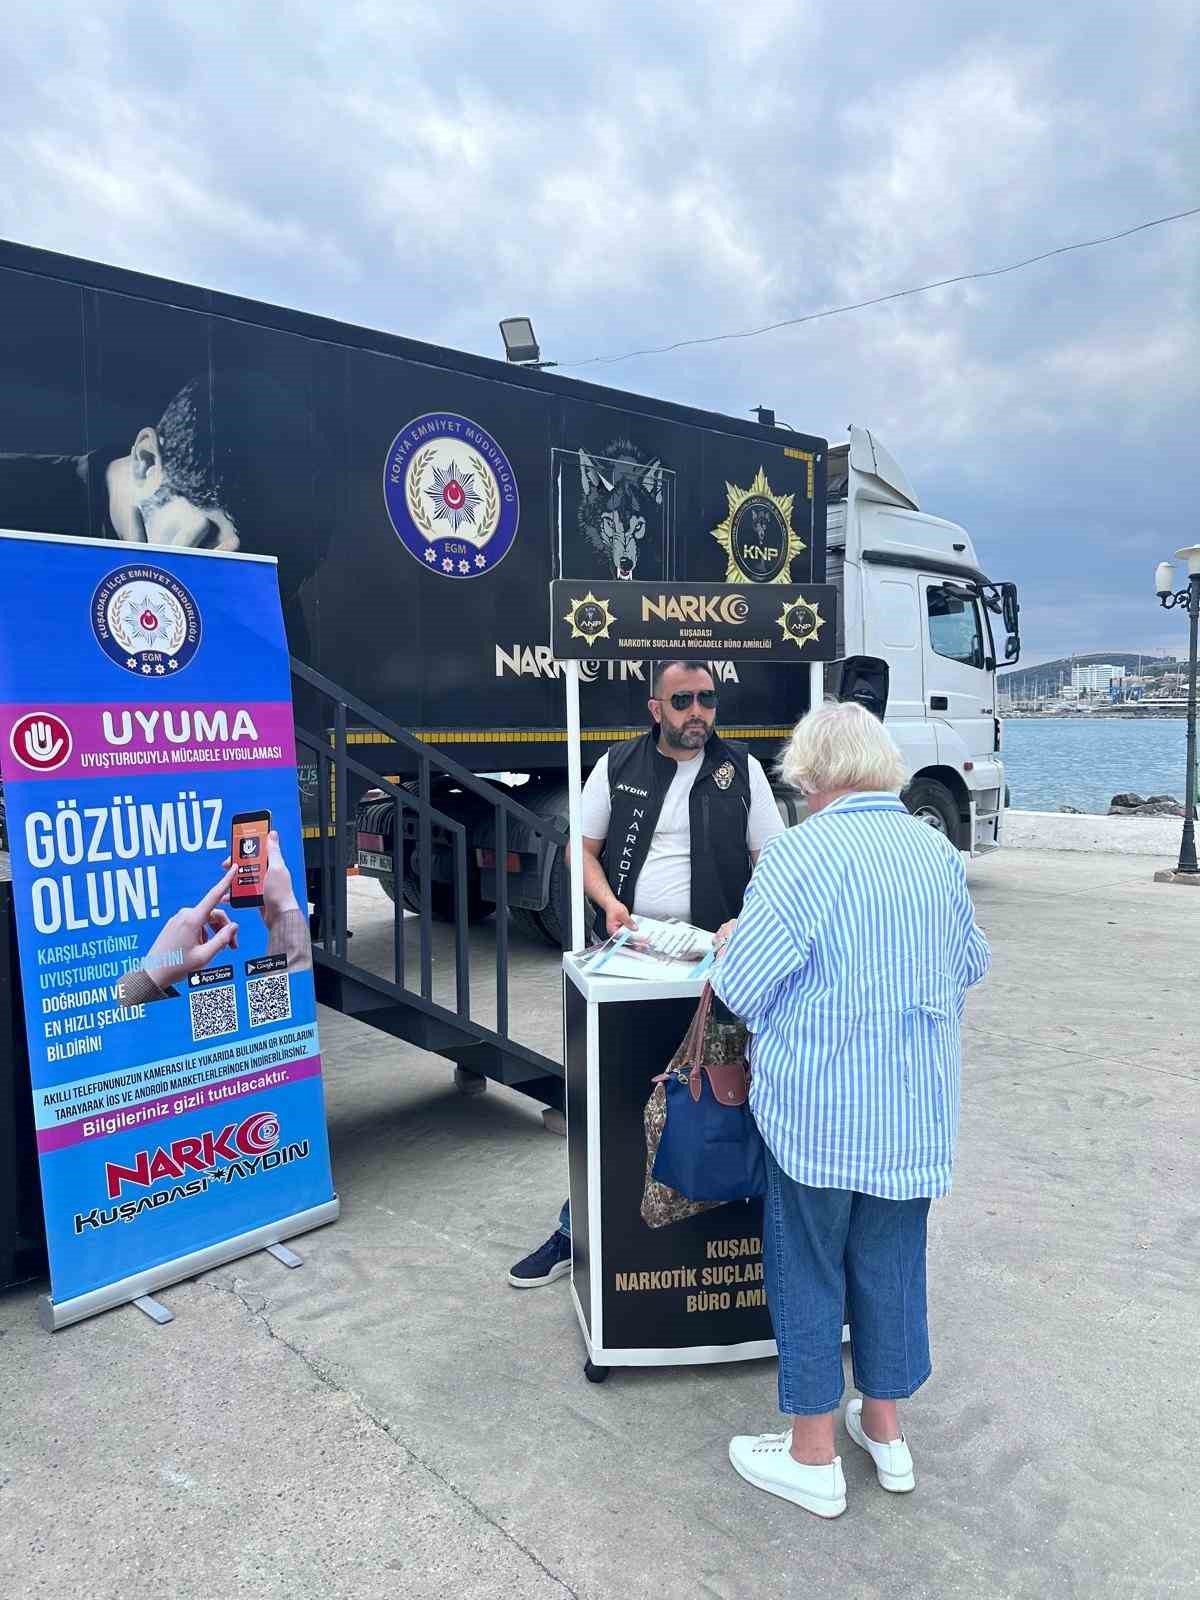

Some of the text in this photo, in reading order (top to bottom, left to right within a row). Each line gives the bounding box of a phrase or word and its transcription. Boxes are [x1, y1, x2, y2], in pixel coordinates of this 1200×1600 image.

[391, 420, 515, 503] KONYA EMNİYET MÜDÜRLÜĞÜ
[444, 543, 467, 554] EGM
[743, 544, 778, 561] KNP
[96, 588, 110, 640] KUŞADASI
[106, 573, 127, 590] İLÇE
[127, 569, 170, 585] EMNİYET
[641, 593, 749, 625] NARKO
[618, 638, 772, 649] NARKOTİK SUÇLARLA MÜCADELE BÜRO AMİRLİĞİ
[679, 629, 712, 638] KUŞADASI
[142, 653, 162, 662] EGM
[102, 709, 258, 745] UYUMA
[80, 746, 282, 769] UYUŞTURUCUYLA MÜCADELE UYGULAMASI
[616, 784, 648, 797] AYDIN
[25, 791, 227, 868] GÖZÜMÜZ
[31, 865, 160, 934] OLUN!
[37, 934, 139, 965] KARŞILAŞTIĞINIZ
[40, 948, 184, 989] UYUŞTURUCU TİCİNİ
[42, 983, 126, 1014] DOĞRUDAN VE
[44, 1003, 146, 1038] EN HIZLI ŞEKİLDE
[47, 1034, 102, 1062] BİLDİRİN!
[43, 1091, 72, 1107] AKILLI
[74, 1072, 142, 1098] TELEFONUNUZUN
[143, 1061, 184, 1081] KAMERASI
[185, 1058, 197, 1070] İLE
[197, 1049, 235, 1066] YUKARIDA
[235, 1042, 268, 1059] BULUNAN
[279, 1029, 314, 1045] KODLARINI
[55, 1100, 104, 1120] TARAYARAK
[121, 1090, 133, 1103] VE
[83, 1070, 290, 1136] Bilgileriniz gizli tutulacaktır.
[106, 1112, 280, 1199] NARKO
[225, 1140, 310, 1184] AYDIN
[707, 1237, 764, 1260] KUŞAD
[615, 1265, 698, 1292] NARKOTİK
[687, 1291, 731, 1313] BÜRO
